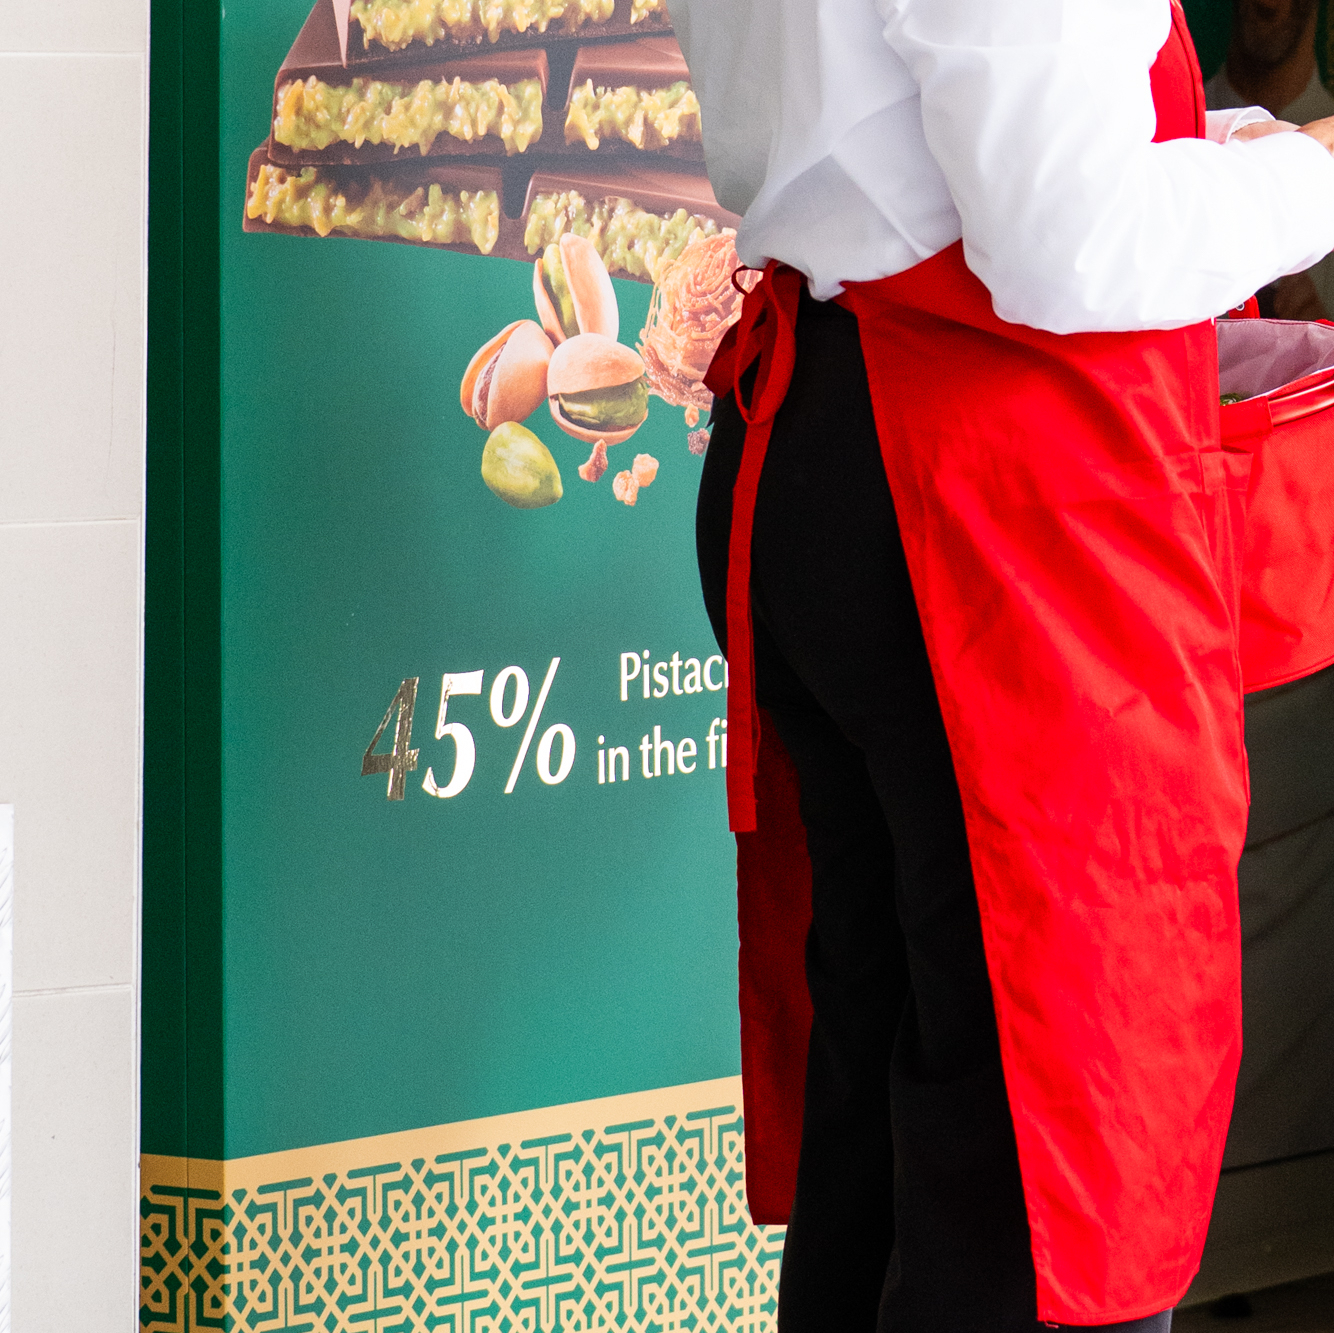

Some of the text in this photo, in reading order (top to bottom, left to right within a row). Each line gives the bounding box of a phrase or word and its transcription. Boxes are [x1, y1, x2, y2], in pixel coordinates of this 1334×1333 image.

[361, 649, 729, 801] 45% Pistac
[597, 716, 728, 785] in the fi
